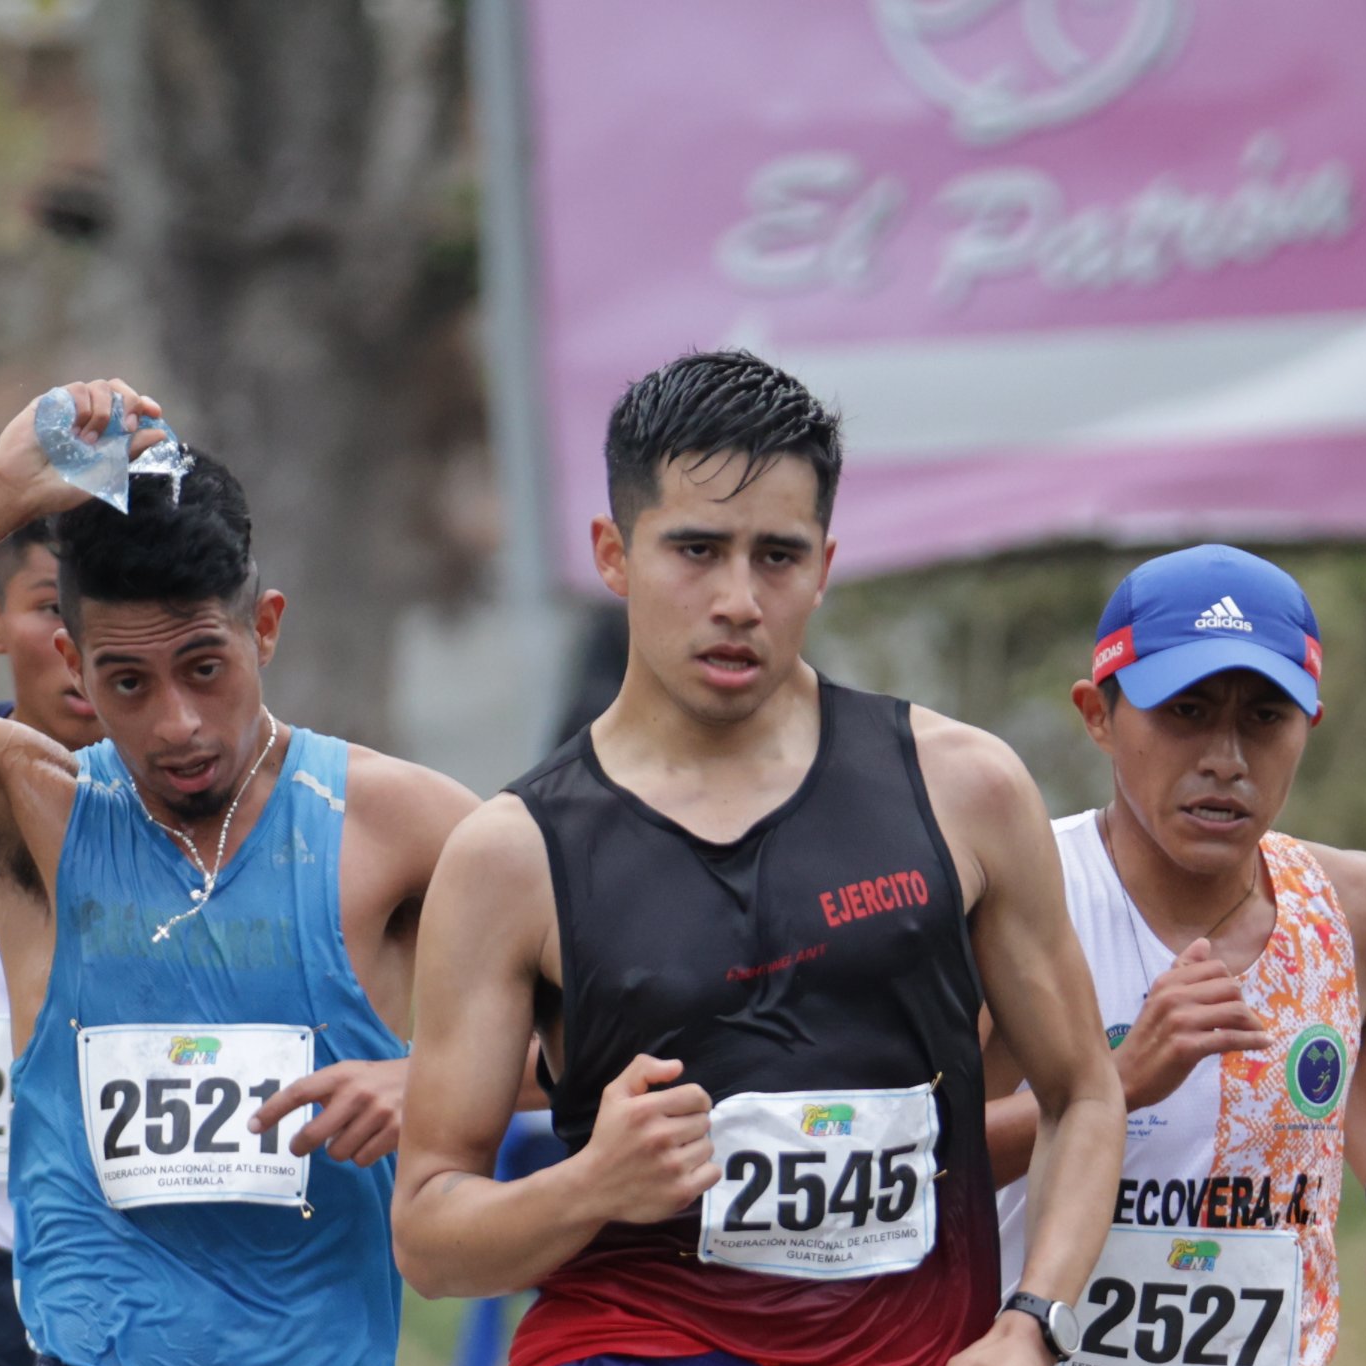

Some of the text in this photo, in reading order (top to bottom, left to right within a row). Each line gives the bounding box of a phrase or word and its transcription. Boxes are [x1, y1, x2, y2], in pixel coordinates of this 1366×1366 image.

[715, 132, 1357, 312] El Patrón
[1195, 615, 1252, 632] adidas
[818, 869, 929, 928] EJERCITO
[99, 1077, 282, 1161] 2521
[158, 1176, 225, 1187] GUATEMALA
[159, 1164, 216, 1175] NACIONAL
[218, 1163, 233, 1173] DE
[235, 1163, 296, 1177] ATLETISMO
[723, 1144, 918, 1232] 2545
[786, 1250, 854, 1263] GUATEMALA
[789, 1238, 845, 1250] NACIONAL
[847, 1237, 861, 1248] DE
[863, 1229, 918, 1246] ATLETISMO
[1080, 1277, 1285, 1366] 2527
